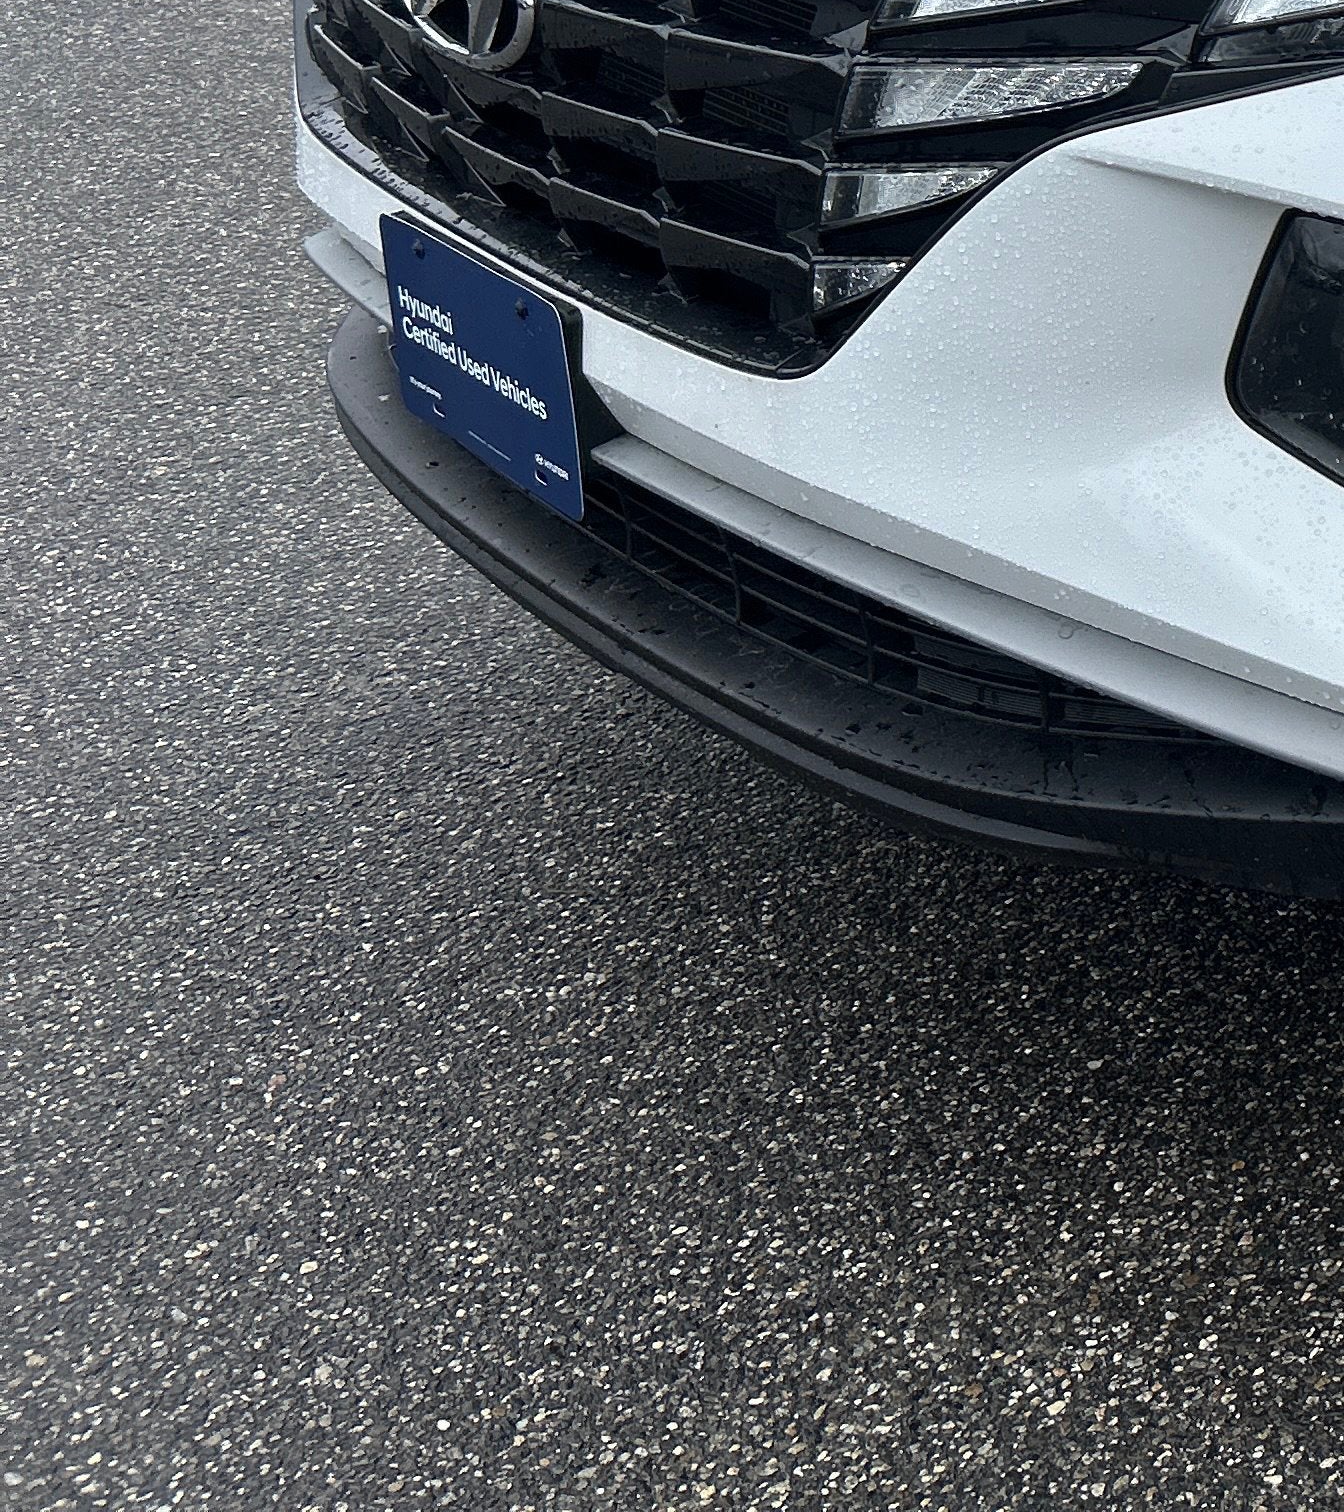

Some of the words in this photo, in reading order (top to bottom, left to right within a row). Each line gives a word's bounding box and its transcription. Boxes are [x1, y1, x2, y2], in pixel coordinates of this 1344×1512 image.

[397, 285, 454, 335] Hyundai
[402, 316, 457, 365] Certified
[457, 346, 490, 386] Used
[489, 366, 548, 420] Vehicles
